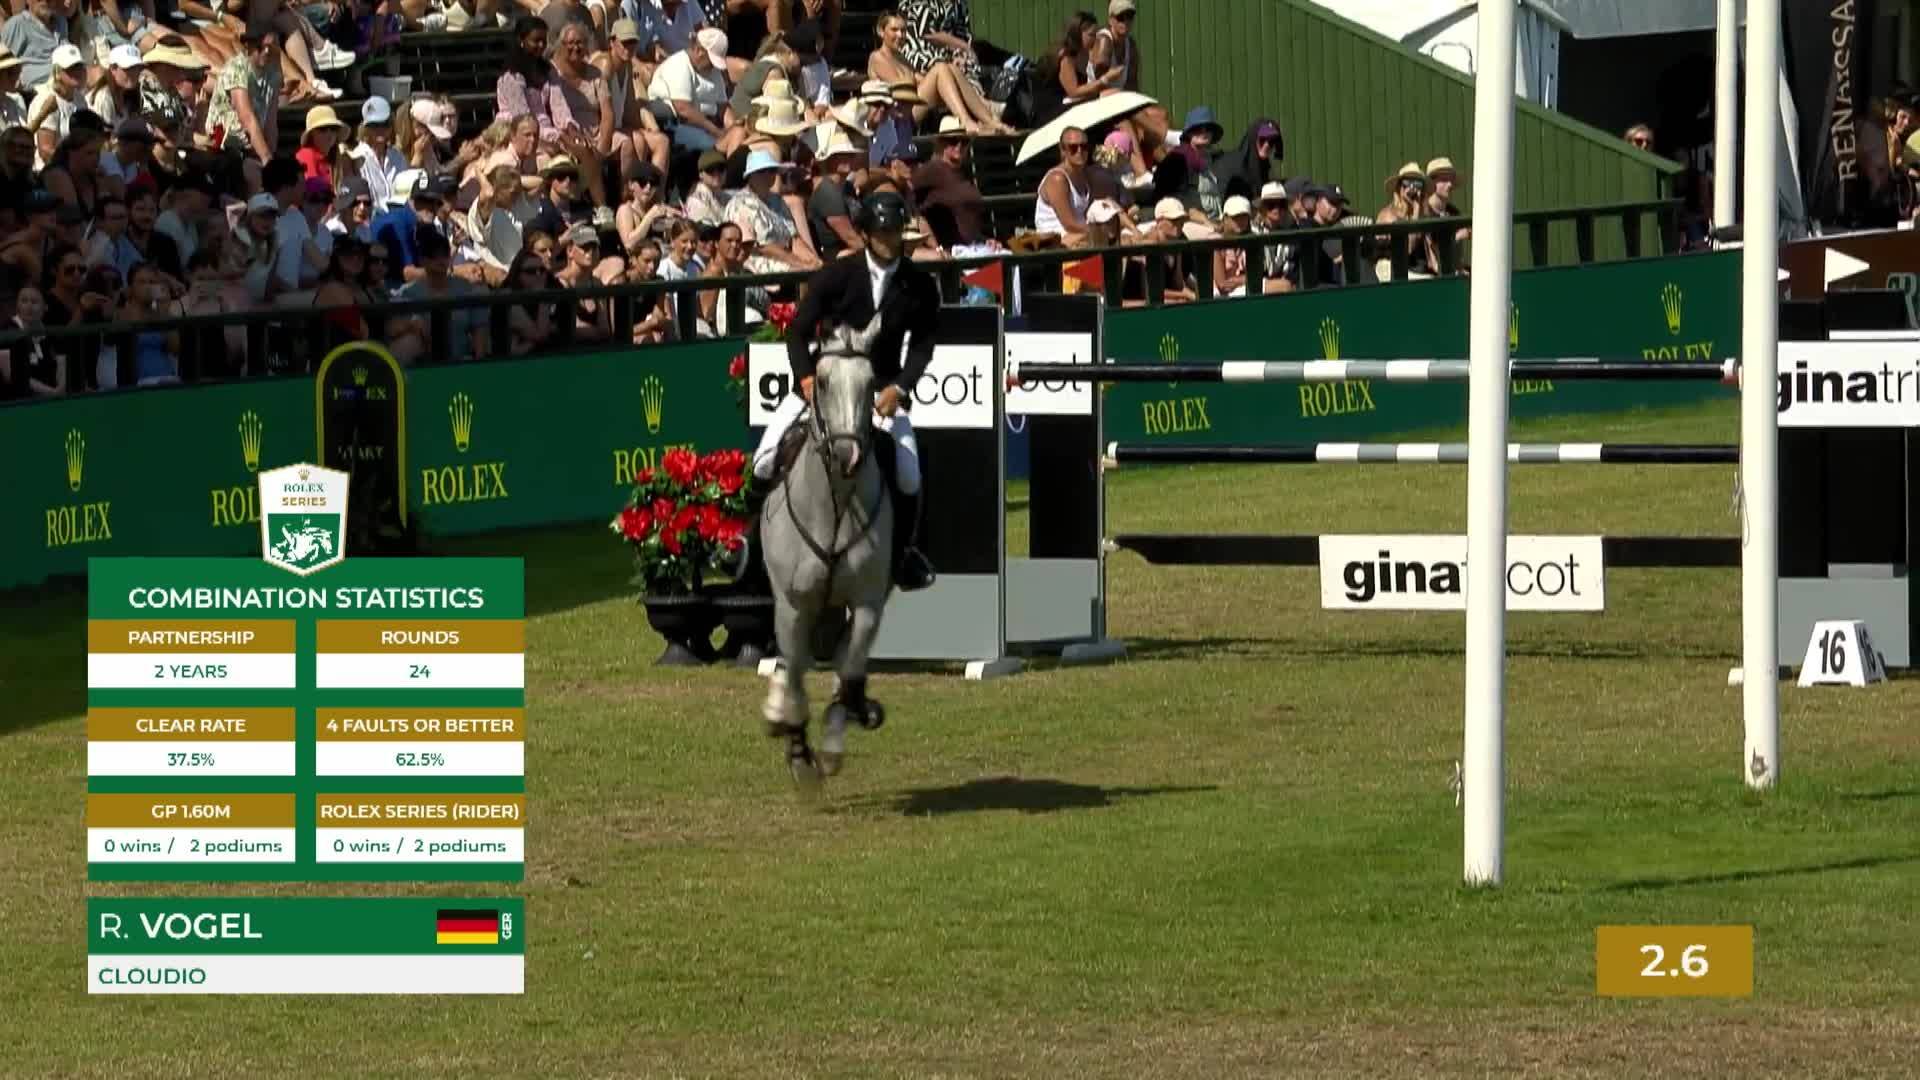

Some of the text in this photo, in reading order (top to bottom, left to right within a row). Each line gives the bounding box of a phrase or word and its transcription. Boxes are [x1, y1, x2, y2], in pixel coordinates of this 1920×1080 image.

[1143, 397, 1211, 434] ROLEX
[1299, 379, 1376, 417] ROLEX
[422, 462, 508, 505] ROLEX
[46, 502, 112, 547] ROLEX
[211, 486, 261, 527] ROL
[1343, 549, 1582, 603] ginacot
[1819, 630, 1846, 674] 16
